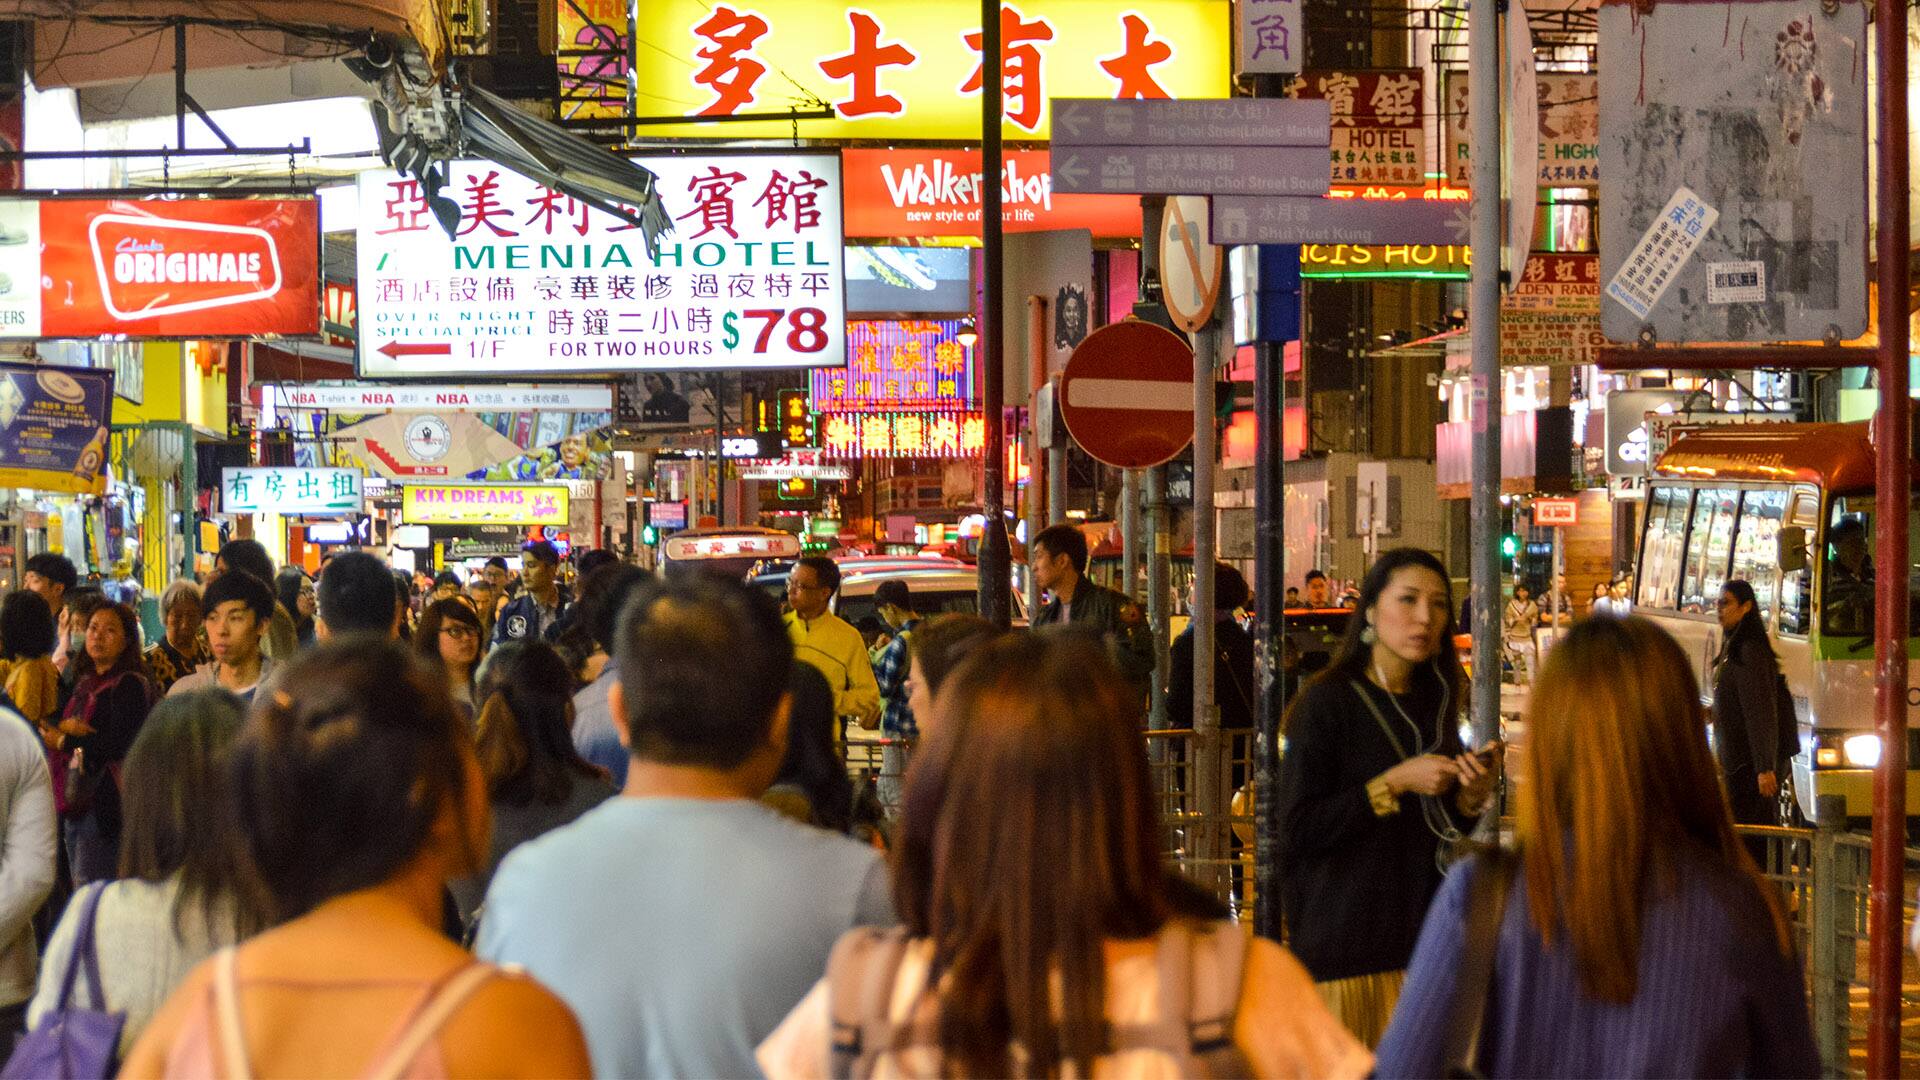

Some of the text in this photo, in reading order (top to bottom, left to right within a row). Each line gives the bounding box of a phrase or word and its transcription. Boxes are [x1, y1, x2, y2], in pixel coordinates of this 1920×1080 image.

[1284, 72, 1420, 126] 賓館
[1147, 125, 1175, 140] Tung
[1178, 124, 1204, 138] Choi
[1350, 130, 1415, 148] HOTEL
[880, 159, 984, 208] Walker
[1146, 175, 1328, 192] Sai Yeung Choi Street South
[376, 166, 829, 240] 亞美利賓館
[907, 211, 931, 222] new
[935, 210, 964, 226] style
[967, 209, 982, 222] of
[1014, 210, 1035, 222] life
[1258, 226, 1373, 245] Shui Yuet Kung
[653, 241, 830, 268] HOTEL
[114, 252, 261, 284] ORIGINALS
[376, 272, 831, 303] 酒店設備 豪華裝修 過夜特平
[460, 310, 537, 321] NIGHT
[549, 306, 714, 337] 時鐘二小時
[474, 325, 534, 336] PRICE
[721, 306, 830, 355] $78
[467, 339, 506, 359] 1/F
[549, 340, 714, 357] FOR TWO HOURS
[292, 393, 317, 404] NBA
[361, 393, 395, 405] NBA
[436, 393, 470, 405] NBA
[227, 470, 359, 502] 有房出租
[415, 489, 525, 504] KIX DREAMS
